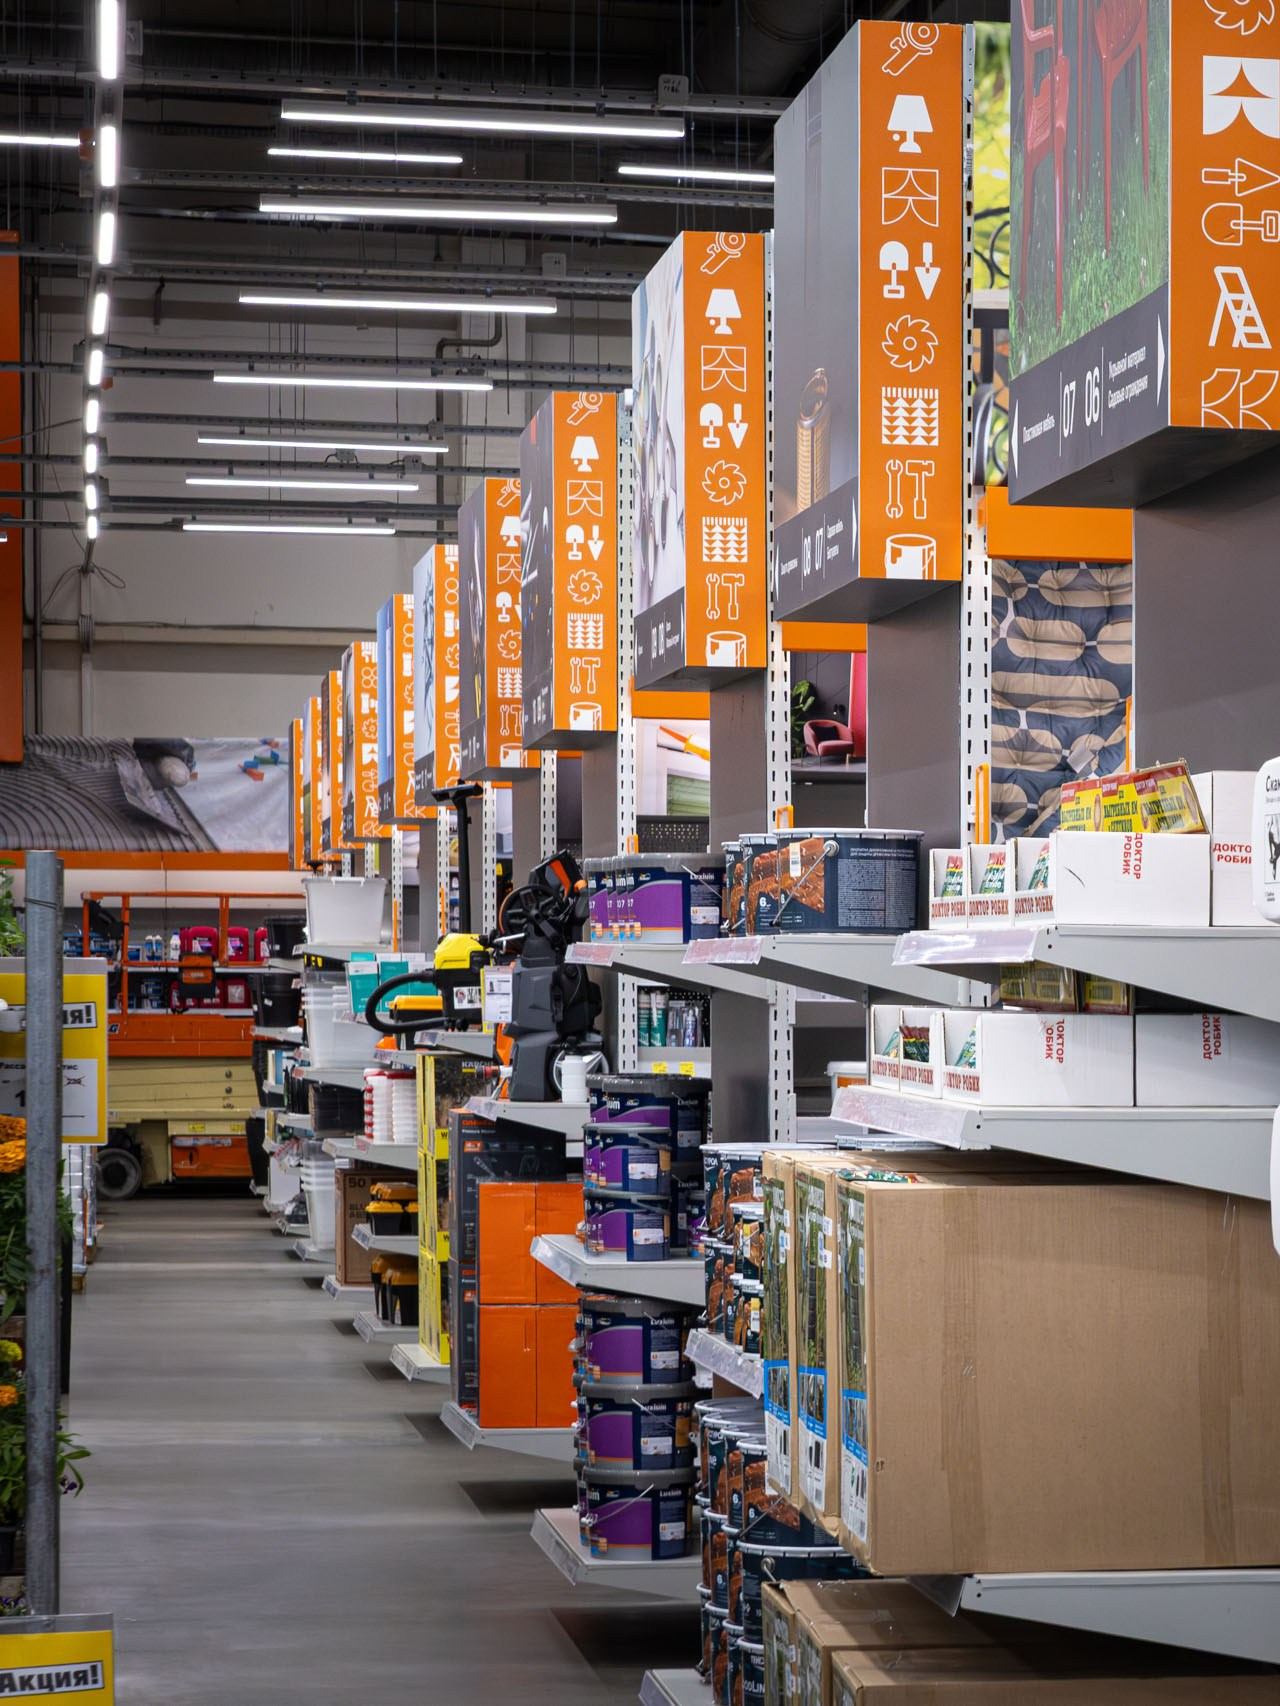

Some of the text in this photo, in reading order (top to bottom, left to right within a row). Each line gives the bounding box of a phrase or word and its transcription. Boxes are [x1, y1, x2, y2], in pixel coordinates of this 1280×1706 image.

[1063, 380, 1076, 438] 07
[1085, 366, 1100, 426] 06
[1123, 835, 1132, 875] РОБИК
[1134, 832, 1143, 880] ДОКТОР
[1213, 842, 1252, 853] ДОКТО
[1217, 854, 1252, 864] РОБИ
[969, 899, 1009, 919] ДОКТОР РОБИК
[1014, 895, 1054, 917] ДОКТОР РОБИК
[1045, 1026, 1054, 1060] ОБИК
[1203, 1012, 1213, 1060] ДОКТОР
[1214, 1016, 1222, 1056] РОБИК
[962, 1074, 980, 1092] РОБИК
[0, 1664, 99, 1693] Акция!
